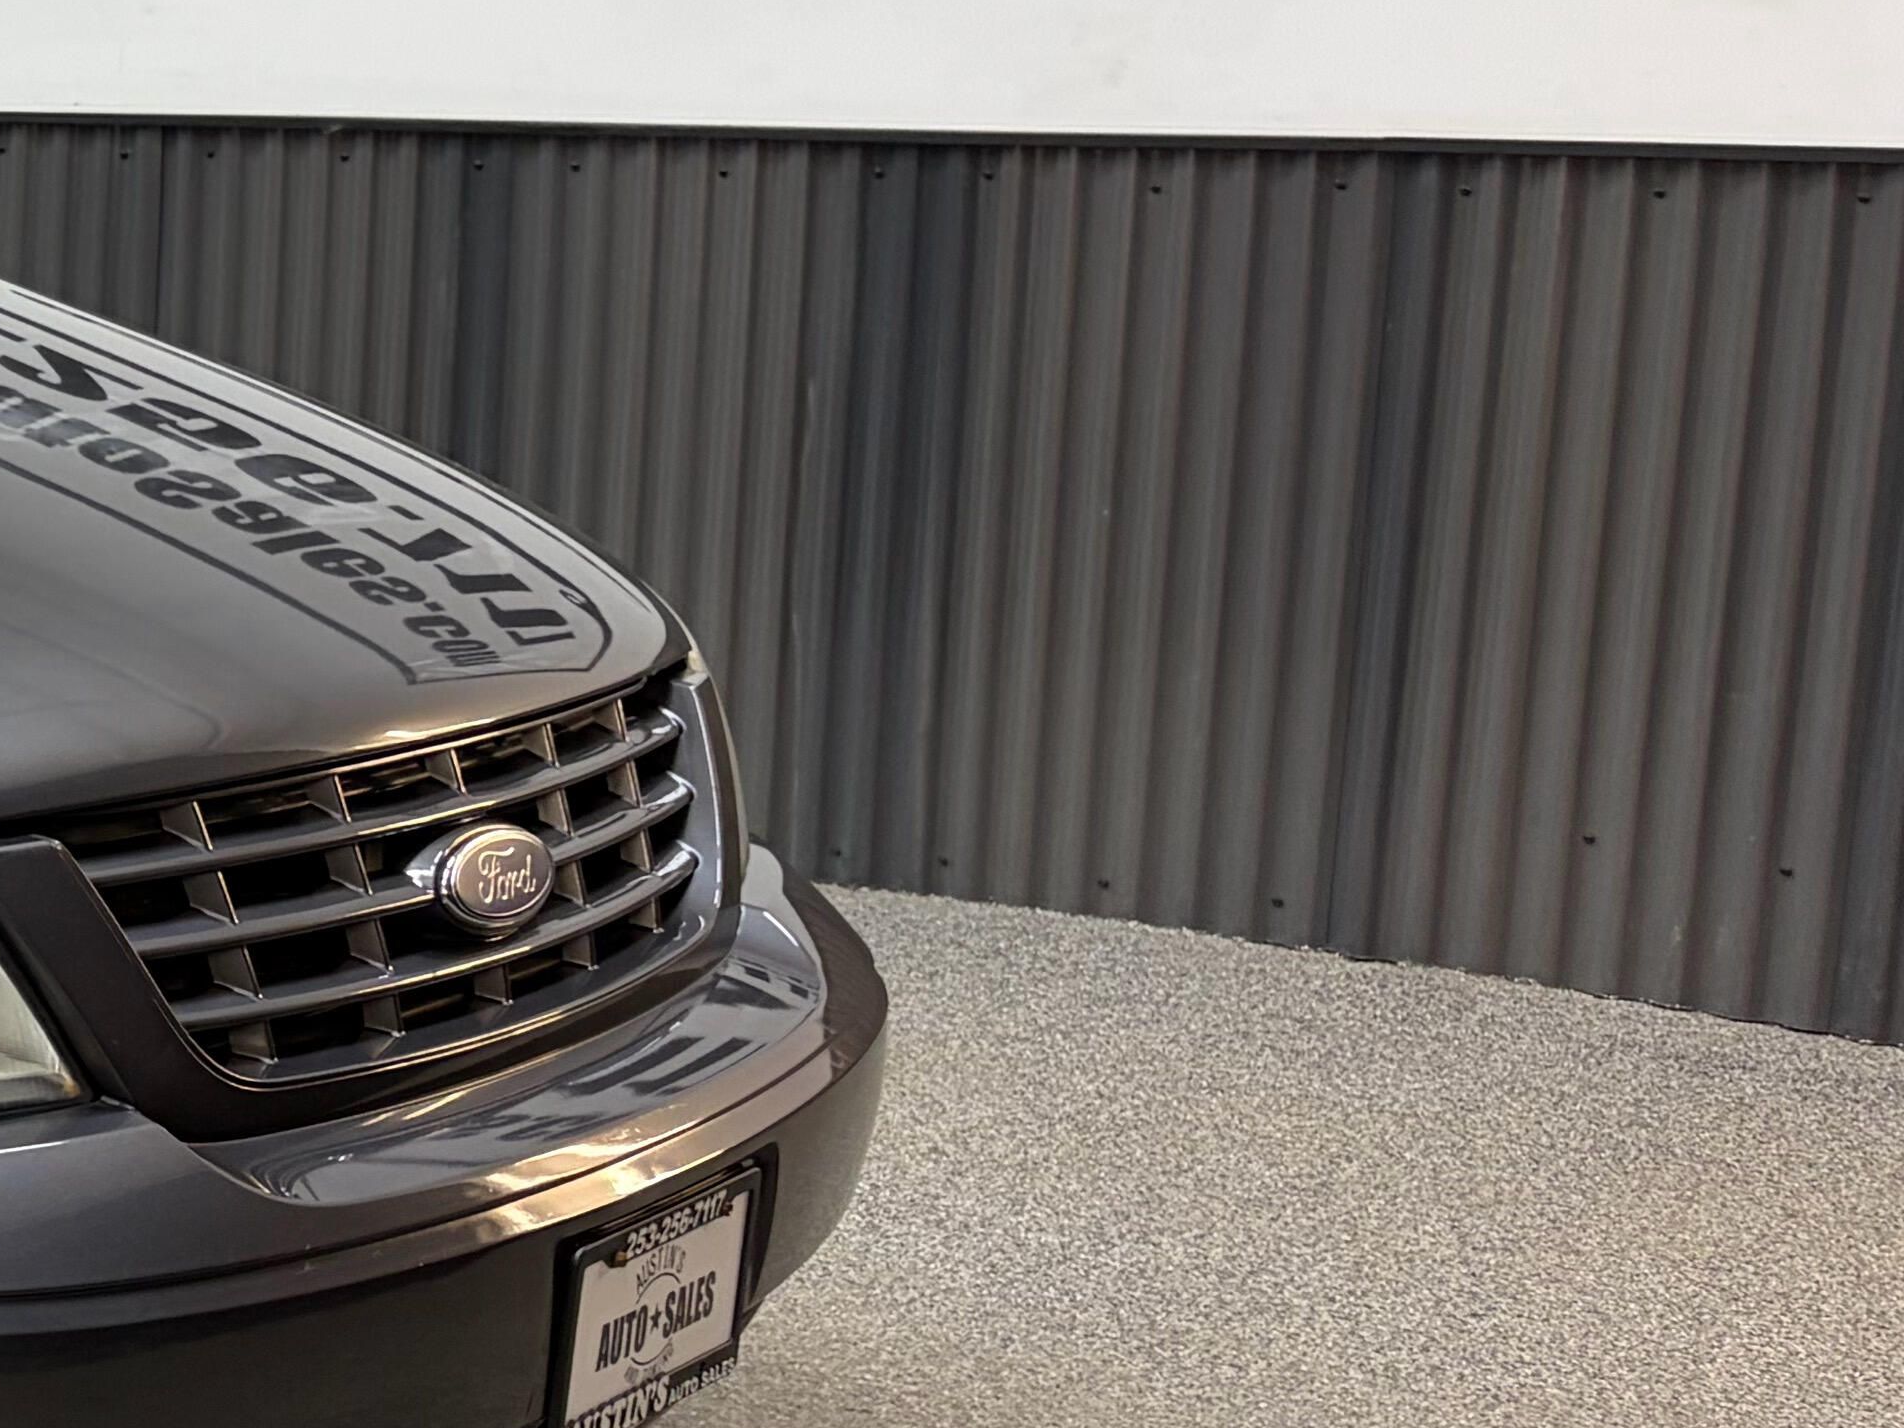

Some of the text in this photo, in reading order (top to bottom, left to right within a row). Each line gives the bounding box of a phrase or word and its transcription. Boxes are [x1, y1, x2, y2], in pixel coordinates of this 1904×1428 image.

[477, 846, 537, 904] Ford
[626, 1188, 728, 1259] 253-256-7117
[595, 1304, 649, 1373] AUTO
[662, 1270, 717, 1339] SALES
